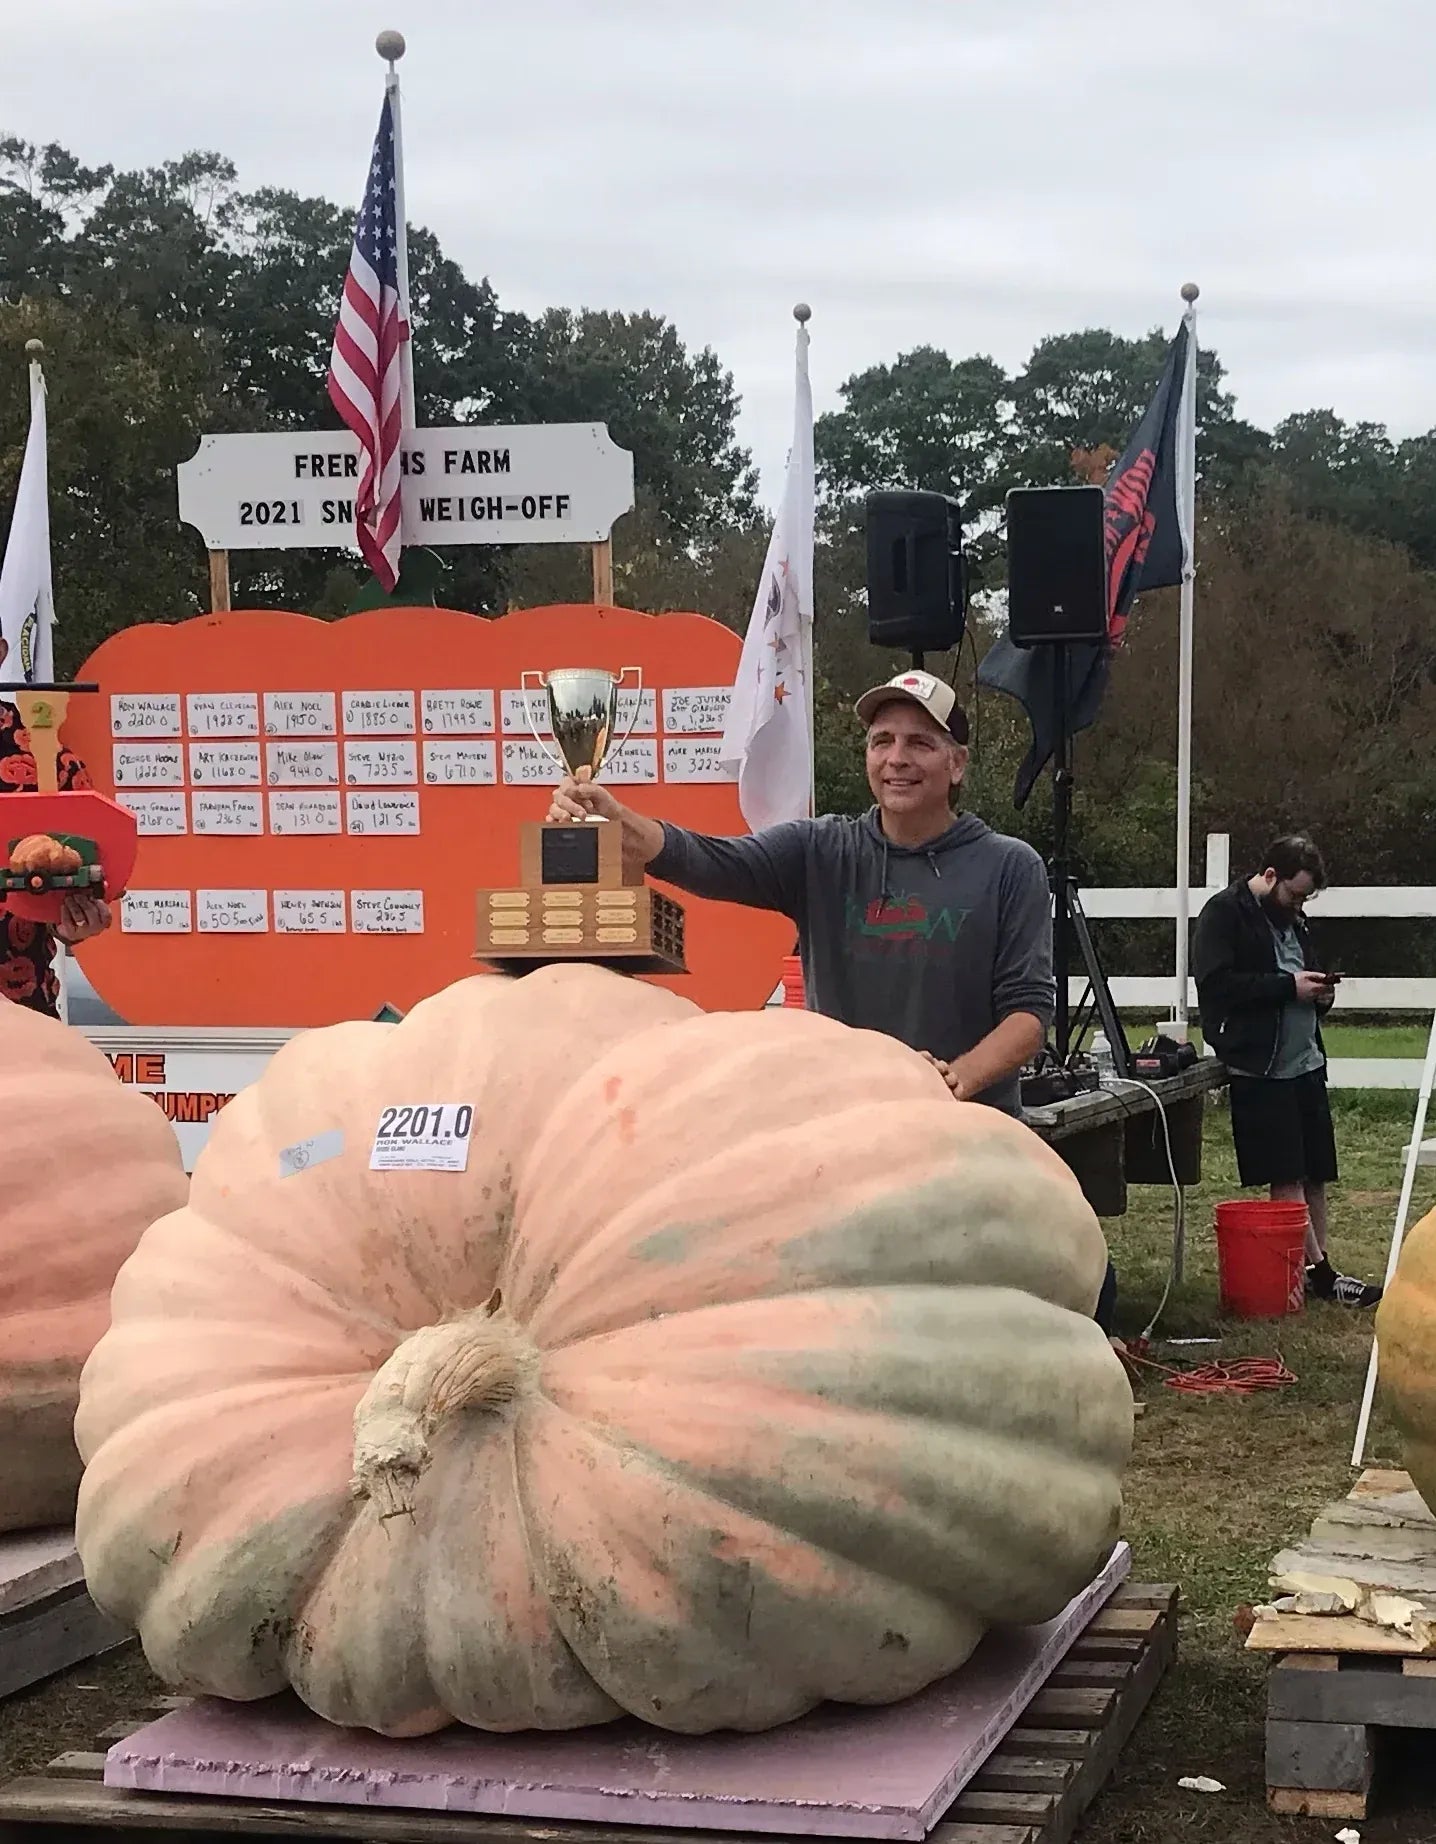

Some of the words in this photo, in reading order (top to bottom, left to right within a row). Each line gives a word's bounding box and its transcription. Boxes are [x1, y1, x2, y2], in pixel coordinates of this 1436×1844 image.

[445, 450, 511, 474] FARM
[240, 501, 301, 526] 2021
[420, 495, 570, 522] WEIGH-OFF
[137, 701, 177, 711] WALLACE
[301, 701, 322, 711] NOEL
[426, 700, 455, 712] BRETT
[460, 699, 483, 709] ROWE
[671, 696, 690, 705] JOE
[695, 695, 731, 704] JUTRAS
[31, 701, 52, 728] 2
[376, 1105, 473, 1139] 2201.0
[402, 1138, 454, 1146] WALLACE
